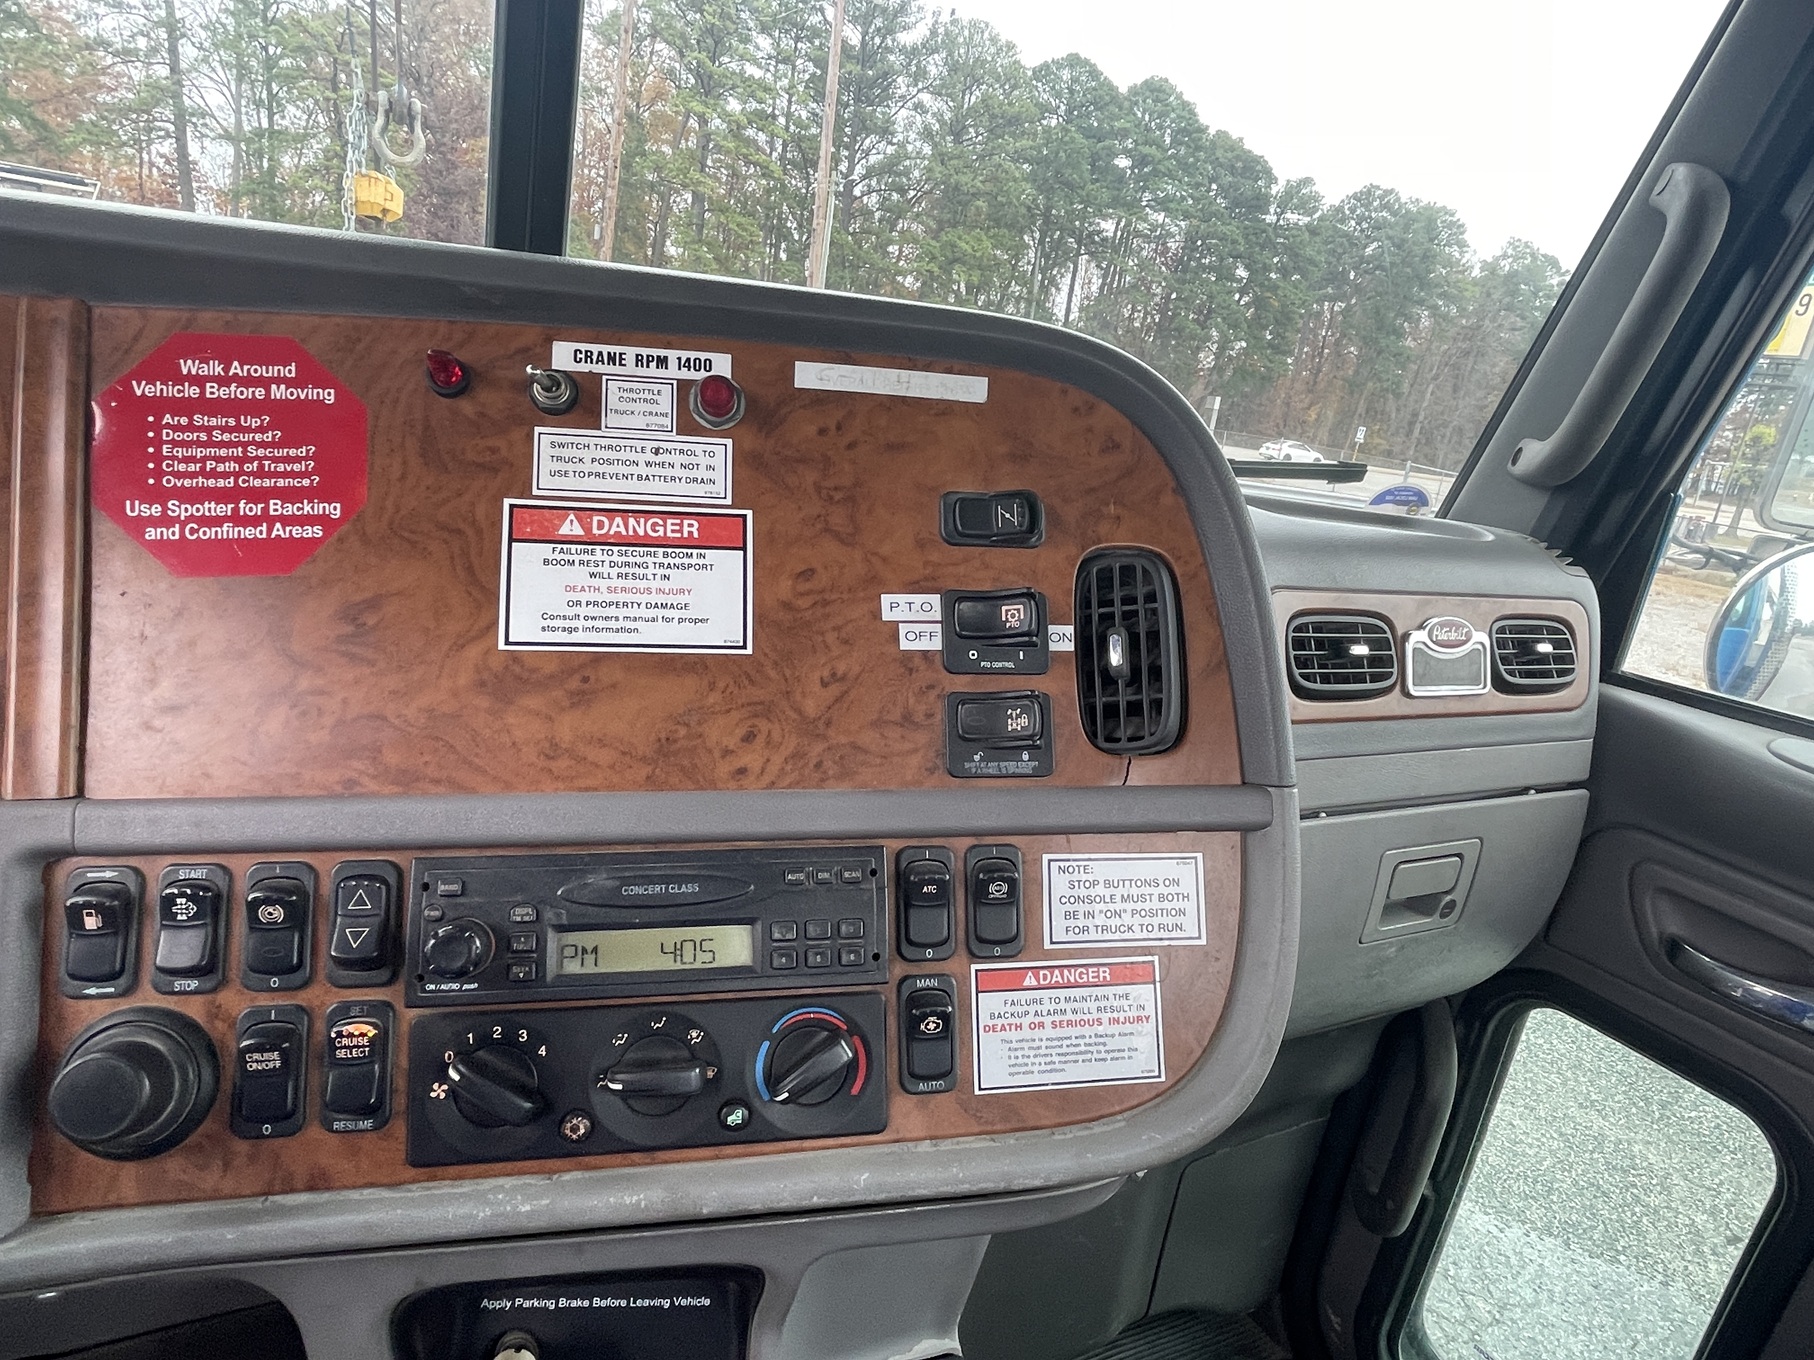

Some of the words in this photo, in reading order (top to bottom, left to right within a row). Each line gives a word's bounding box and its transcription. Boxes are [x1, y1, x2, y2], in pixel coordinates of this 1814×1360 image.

[1795, 293, 1812, 316] 9
[573, 349, 627, 367] CRANE
[635, 354, 669, 370] RPM
[676, 357, 712, 372] 1400
[180, 360, 224, 376] Walk
[229, 362, 296, 378] Around
[132, 380, 200, 398] Vehicle
[206, 383, 265, 399] Before
[271, 384, 334, 404] Moving
[618, 387, 662, 396] THROTTLE
[618, 396, 660, 405] CONTROL
[609, 408, 636, 416] TRUCK
[162, 414, 188, 425] Are
[193, 415, 236, 426] Stairs
[240, 416, 270, 428] Up?
[162, 430, 207, 441] Doors
[212, 430, 281, 442] Secured?
[162, 446, 242, 458] Equipment
[247, 446, 315, 456] Secured?
[550, 441, 590, 450] SWITCH
[594, 443, 646, 454] THROTTLE
[651, 447, 699, 457] CONTROL
[703, 450, 715, 458] TO
[162, 460, 201, 472] Clear
[206, 460, 239, 472] Path
[244, 460, 258, 472] of
[262, 460, 314, 472] Travel?
[550, 456, 585, 464] TRUCK
[591, 457, 639, 468] POSITION
[645, 460, 675, 469] WHEN
[680, 462, 700, 471] NOT
[162, 476, 234, 487] Overhead
[238, 476, 320, 487] Clearance?
[550, 470, 570, 479] USE
[572, 471, 585, 479] TO
[588, 471, 635, 482] PREVENT
[637, 474, 683, 483] BATTERY
[685, 477, 715, 485] DRAIN
[126, 500, 162, 516] Use
[167, 500, 234, 520] Spotter
[239, 500, 264, 515] for
[269, 500, 341, 518] Backing
[145, 524, 179, 540] and
[185, 523, 267, 540] Confined
[272, 523, 322, 538] Areas
[592, 516, 699, 538] DANGER
[552, 547, 597, 557] FAILURE
[600, 548, 614, 557] TO
[617, 549, 659, 558] SECURE
[663, 551, 693, 560] BOOM
[697, 552, 706, 560] IN
[543, 558, 575, 567] BOOM
[579, 560, 605, 568] REST
[609, 561, 649, 570] DURING
[652, 562, 714, 572] TRANSPORT
[589, 571, 613, 580] WILL
[617, 572, 657, 581] RESULT
[565, 585, 603, 595] DEATH,
[607, 586, 653, 595] SERIOUS
[656, 587, 692, 596] INJURY
[567, 600, 582, 608] OR
[586, 601, 642, 609] PROPERTY
[645, 602, 690, 610] DAMAGE
[890, 602, 937, 612] P.T.O.
[541, 613, 580, 622] Consult
[584, 615, 620, 623] owners
[623, 614, 658, 623] manual
[662, 615, 675, 623] for
[678, 617, 709, 626] proper
[541, 625, 579, 634] storage
[582, 625, 641, 634] information.
[1433, 625, 1469, 641] Peterbilt
[905, 631, 938, 641] OFF
[1049, 633, 1072, 643] ON
[179, 870, 207, 879] START
[1058, 865, 1094, 874] NOTE:
[622, 885, 666, 895] CONCERT
[669, 883, 699, 893] CLASS
[1068, 880, 1099, 890] STOP
[1104, 878, 1159, 889] BUTTONS
[1163, 878, 1180, 887] ON
[1059, 894, 1116, 905] CONSOLE
[1121, 893, 1154, 904] MUST
[1158, 893, 1189, 902] BOTH
[1064, 911, 1079, 920] BE
[1084, 910, 1095, 919] IN
[1099, 909, 1127, 919] "ON"
[1131, 908, 1186, 918] POSITION
[1066, 925, 1090, 935] FOR
[1094, 924, 1135, 934] TRUCK
[1139, 924, 1154, 933] TO
[1158, 923, 1186, 932] RUN.
[1039, 968, 1111, 985] DANGER
[174, 981, 198, 991] STOP
[917, 979, 937, 987] MAN
[1004, 999, 1044, 1007] FAILURE
[1049, 997, 1061, 1005] TO
[1065, 995, 1109, 1004] MAINTAIN
[1113, 993, 1131, 1001] THE
[990, 1011, 1029, 1020] BACKUP
[1034, 1009, 1067, 1018] ALARM
[1071, 1007, 1093, 1015] WILL
[1097, 1005, 1133, 1013] RESULT
[1136, 1004, 1145, 1012] IN
[983, 1023, 1023, 1033] DEATH
[1029, 1022, 1045, 1030] OR
[1051, 1018, 1103, 1029] SERIOUS
[1108, 1015, 1151, 1025] INJURY
[467, 1033, 473, 1044] 1
[493, 1027, 501, 1038] 2
[519, 1030, 528, 1041] 3
[1045, 1035, 1072, 1043] equipped
[1094, 1032, 1115, 1040] Backup
[335, 1037, 369, 1047] CRUISE
[246, 1052, 280, 1061] CRUISE
[336, 1048, 370, 1058] SELECT
[445, 1051, 453, 1062] 0
[538, 1046, 546, 1056] 4
[247, 1061, 281, 1070] ON/OFF
[918, 1081, 944, 1091] AUTO
[333, 1120, 373, 1130] RESUME
[481, 1298, 512, 1309] Apply
[515, 1298, 555, 1309] Parking
[558, 1298, 589, 1308] Brake
[593, 1297, 626, 1307] Before
[630, 1297, 670, 1308] Leaving
[674, 1296, 710, 1306] Vehicle
